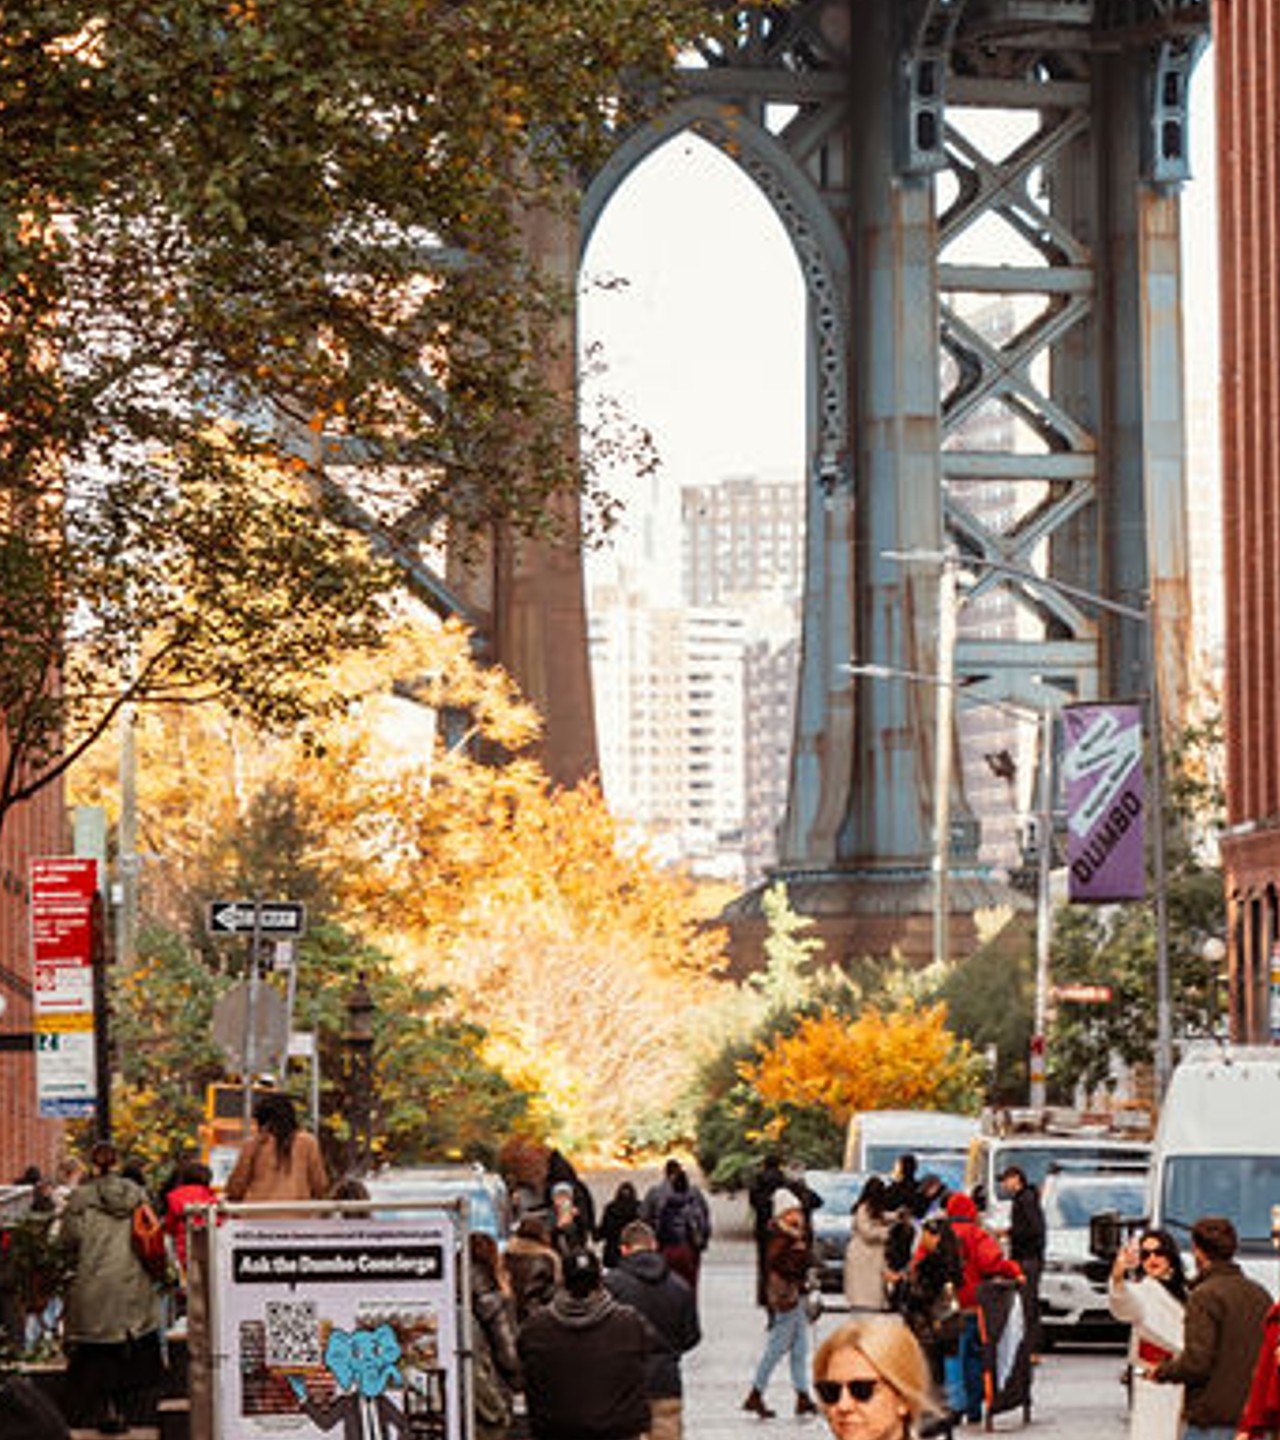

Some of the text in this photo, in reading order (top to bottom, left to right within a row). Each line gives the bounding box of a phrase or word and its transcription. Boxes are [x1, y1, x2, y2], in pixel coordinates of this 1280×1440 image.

[1072, 790, 1142, 885] DUMBO
[239, 1252, 437, 1276] Ask the Dumbo Concierge
